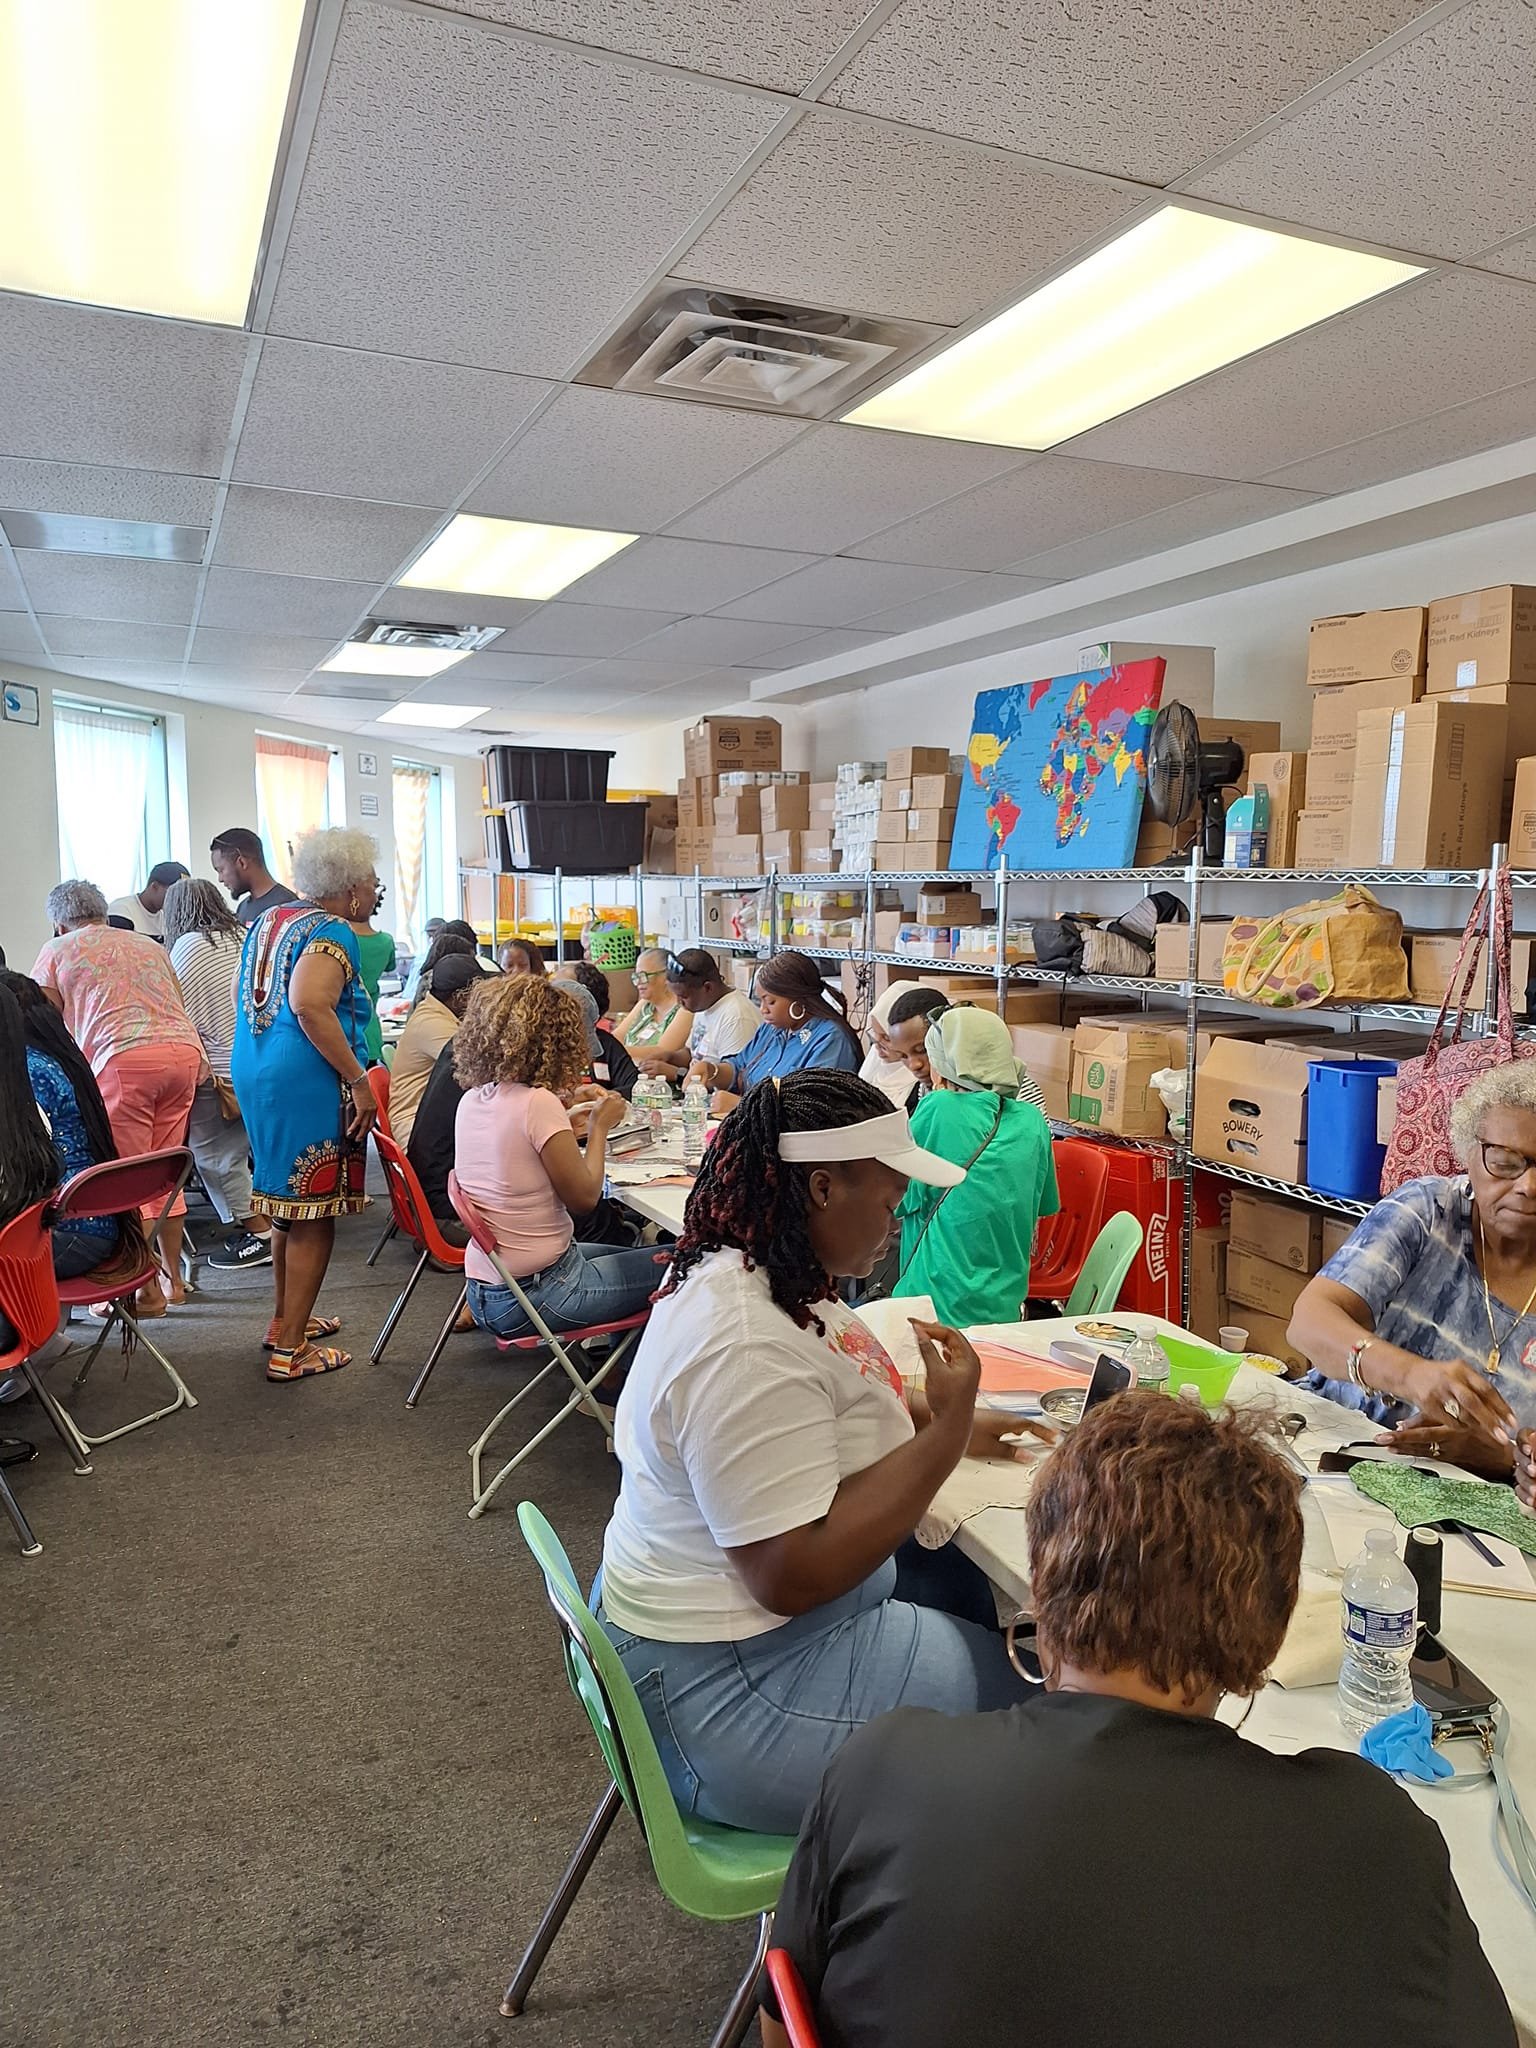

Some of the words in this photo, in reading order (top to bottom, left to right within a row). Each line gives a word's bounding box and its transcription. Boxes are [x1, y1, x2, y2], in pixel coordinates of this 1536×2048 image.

[1449, 632, 1466, 642] Red
[1467, 627, 1501, 640] Kidneys
[1459, 782, 1468, 822] Kidneys
[1456, 824, 1465, 843] Red
[1222, 1120, 1264, 1141] BOWERY
[238, 1241, 264, 1259] HOKA
[1151, 1219, 1167, 1275] HEINZ
